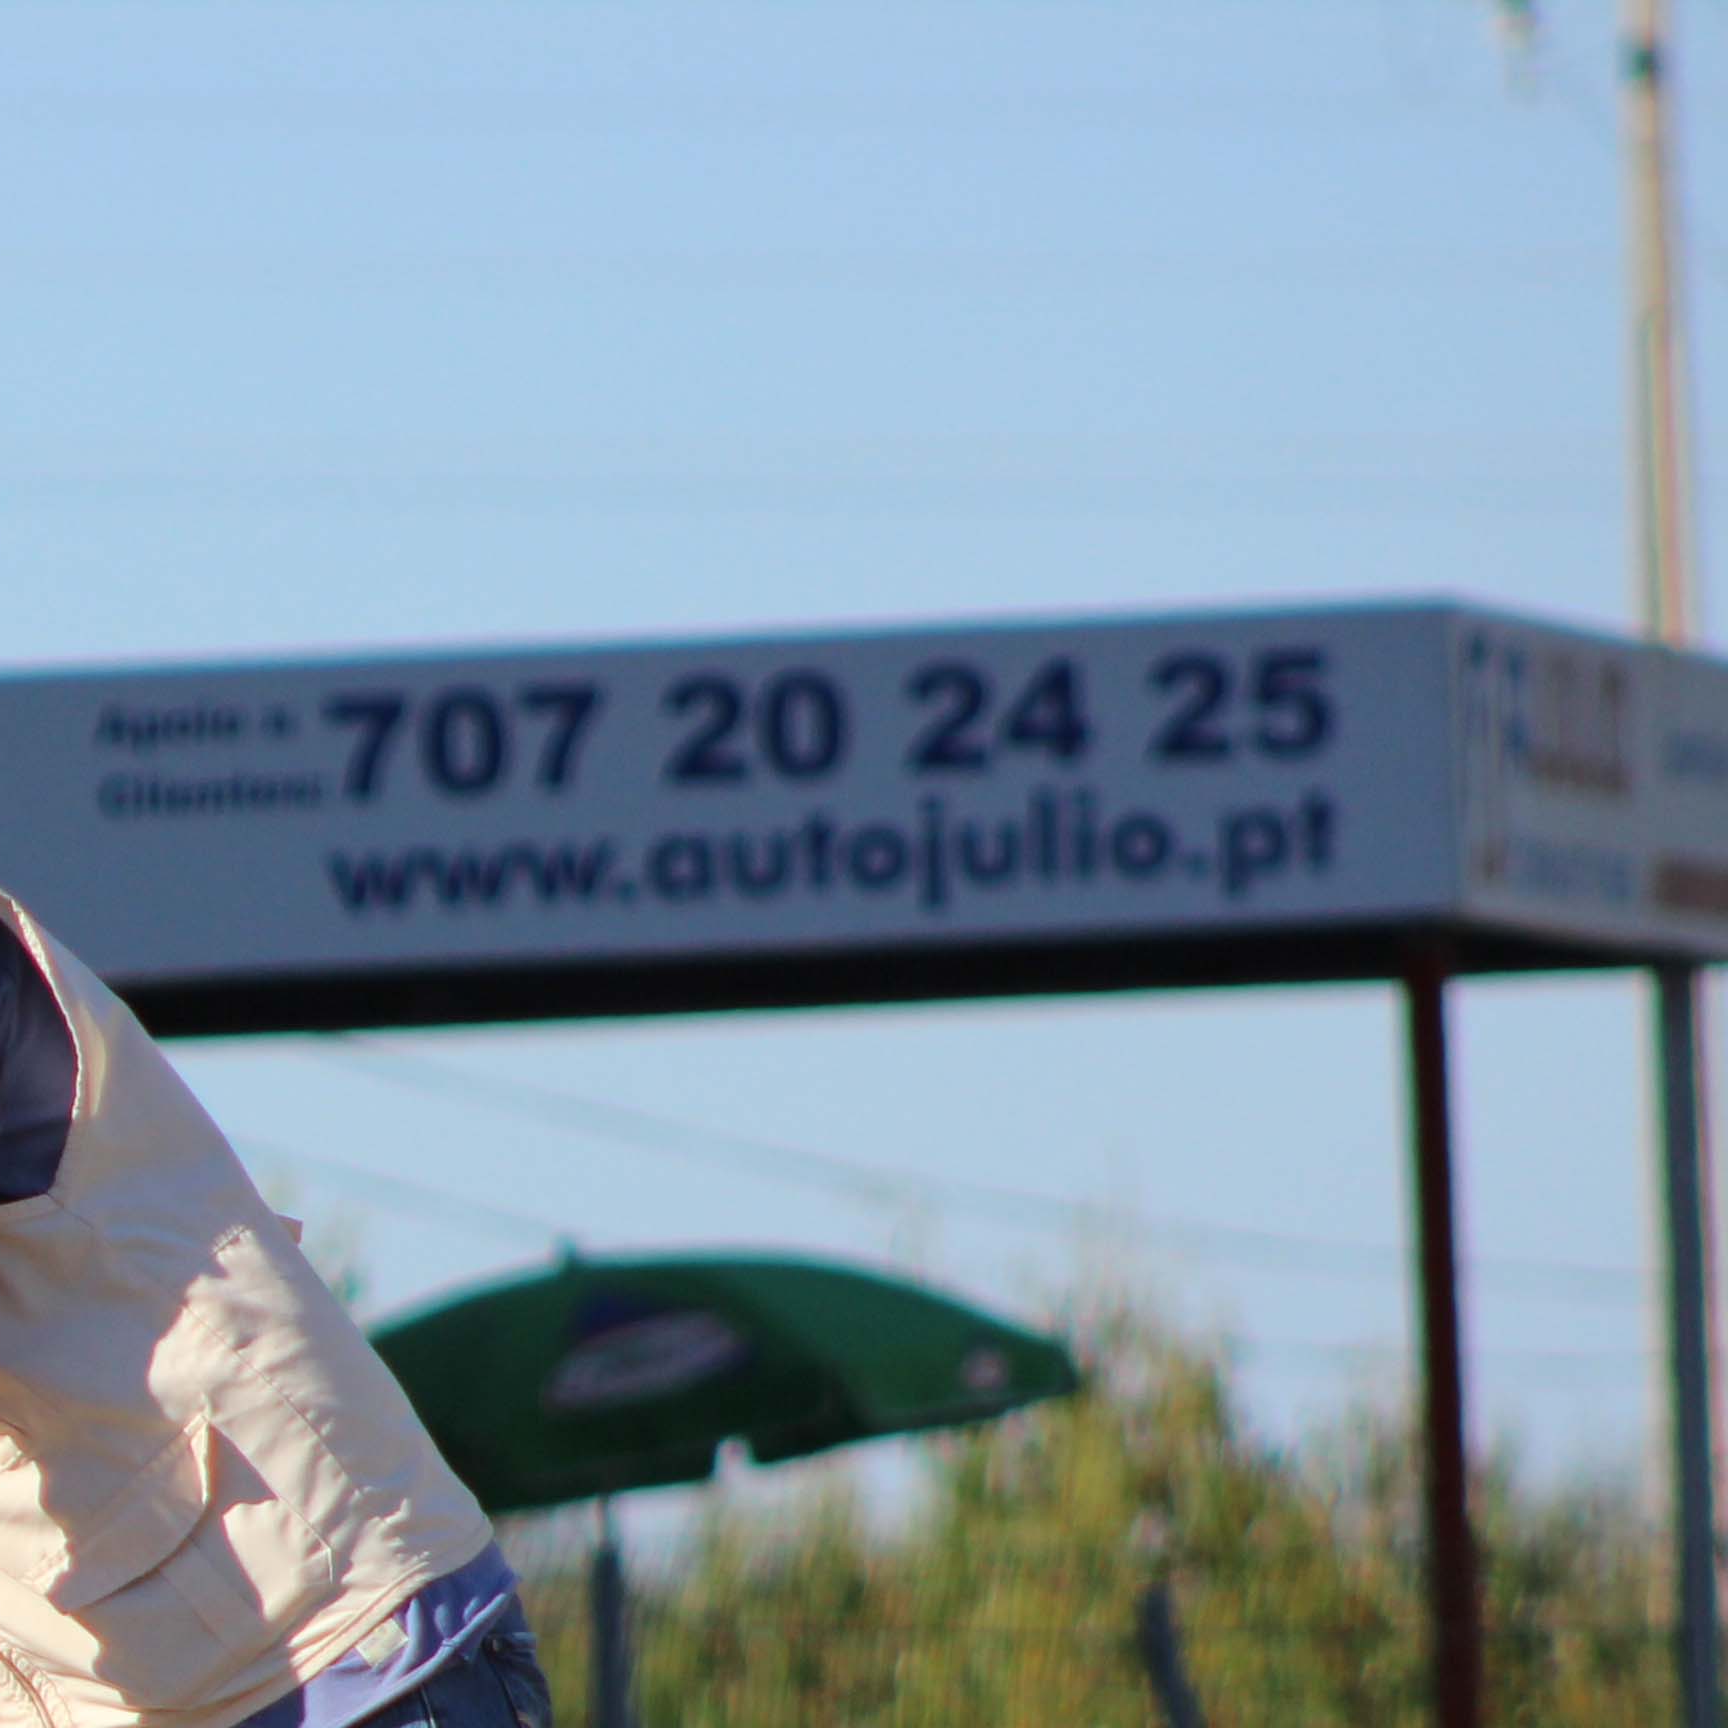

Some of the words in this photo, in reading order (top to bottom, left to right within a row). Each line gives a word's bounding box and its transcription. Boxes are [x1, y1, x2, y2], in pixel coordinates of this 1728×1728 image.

[324, 685, 602, 798] 707
[662, 668, 848, 788] 20
[906, 655, 1090, 773] 24
[1152, 647, 1332, 765] 25
[328, 786, 1334, 914] www.autojulio.pt
